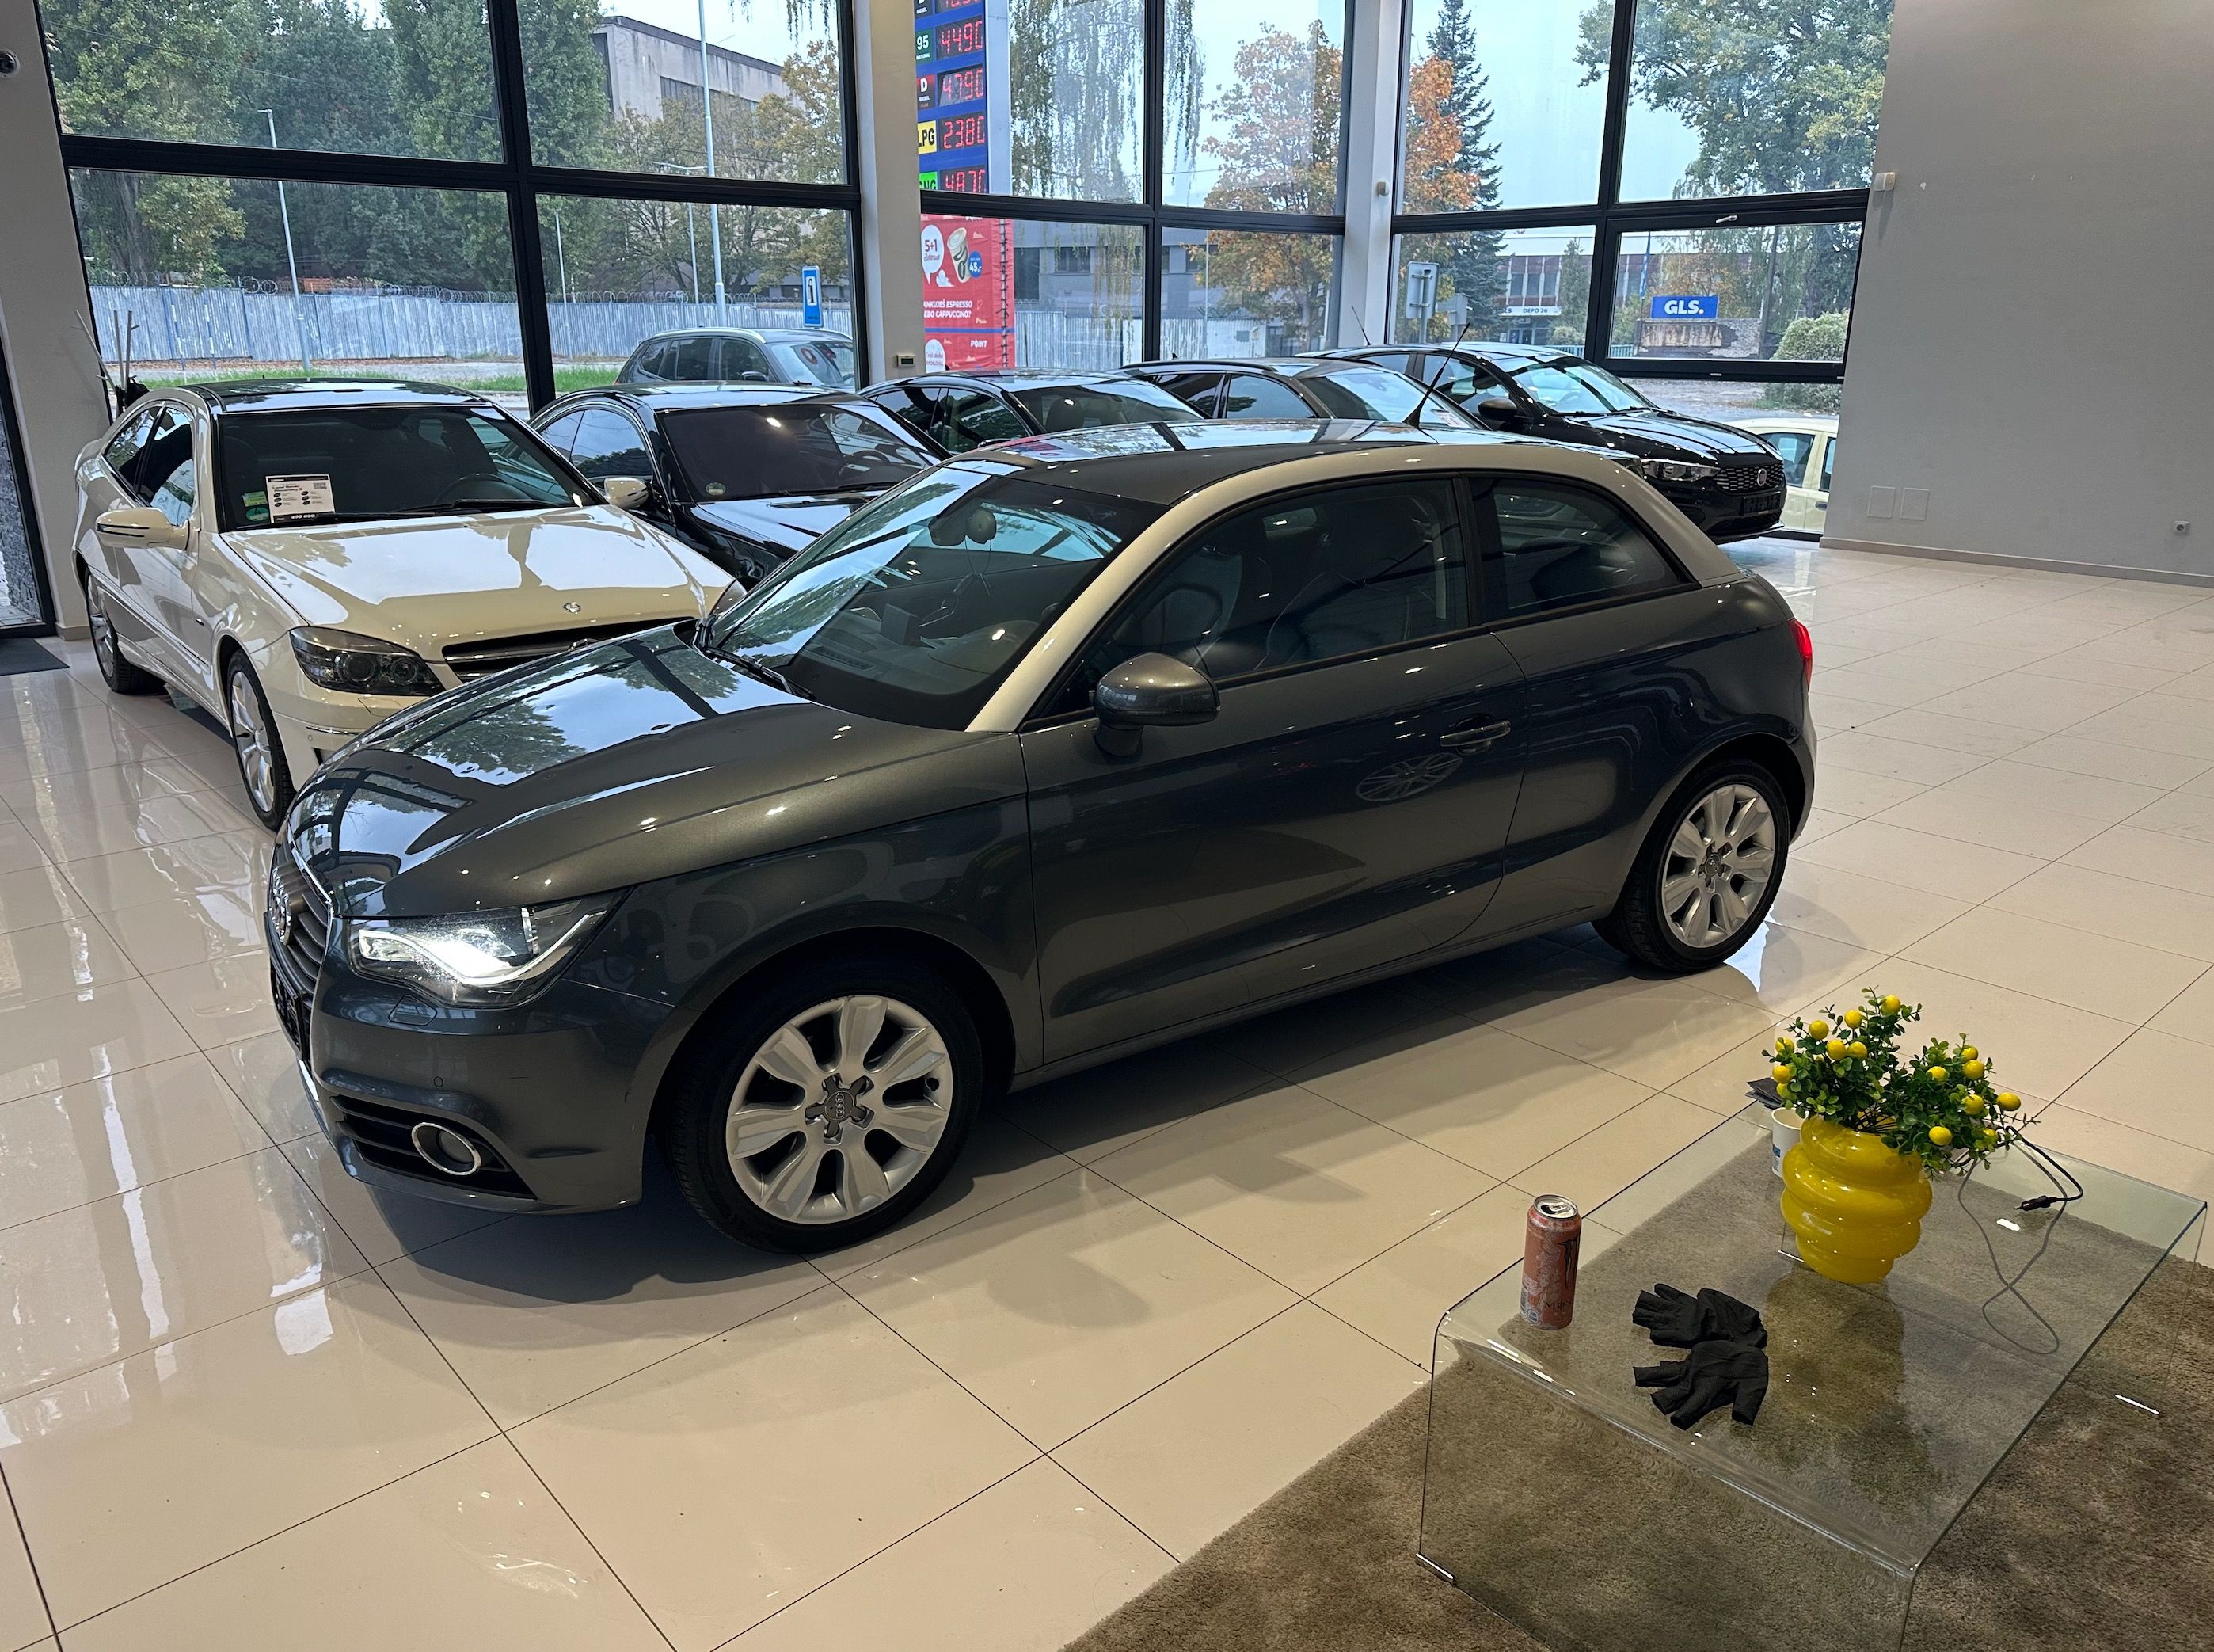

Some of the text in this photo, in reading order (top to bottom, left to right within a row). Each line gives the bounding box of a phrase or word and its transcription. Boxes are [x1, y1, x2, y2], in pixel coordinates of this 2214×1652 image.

[917, 34, 929, 51] 95
[920, 78, 928, 93] D
[919, 179, 936, 190] NG
[924, 238, 938, 253] 5+1
[970, 340, 988, 348] POINT
